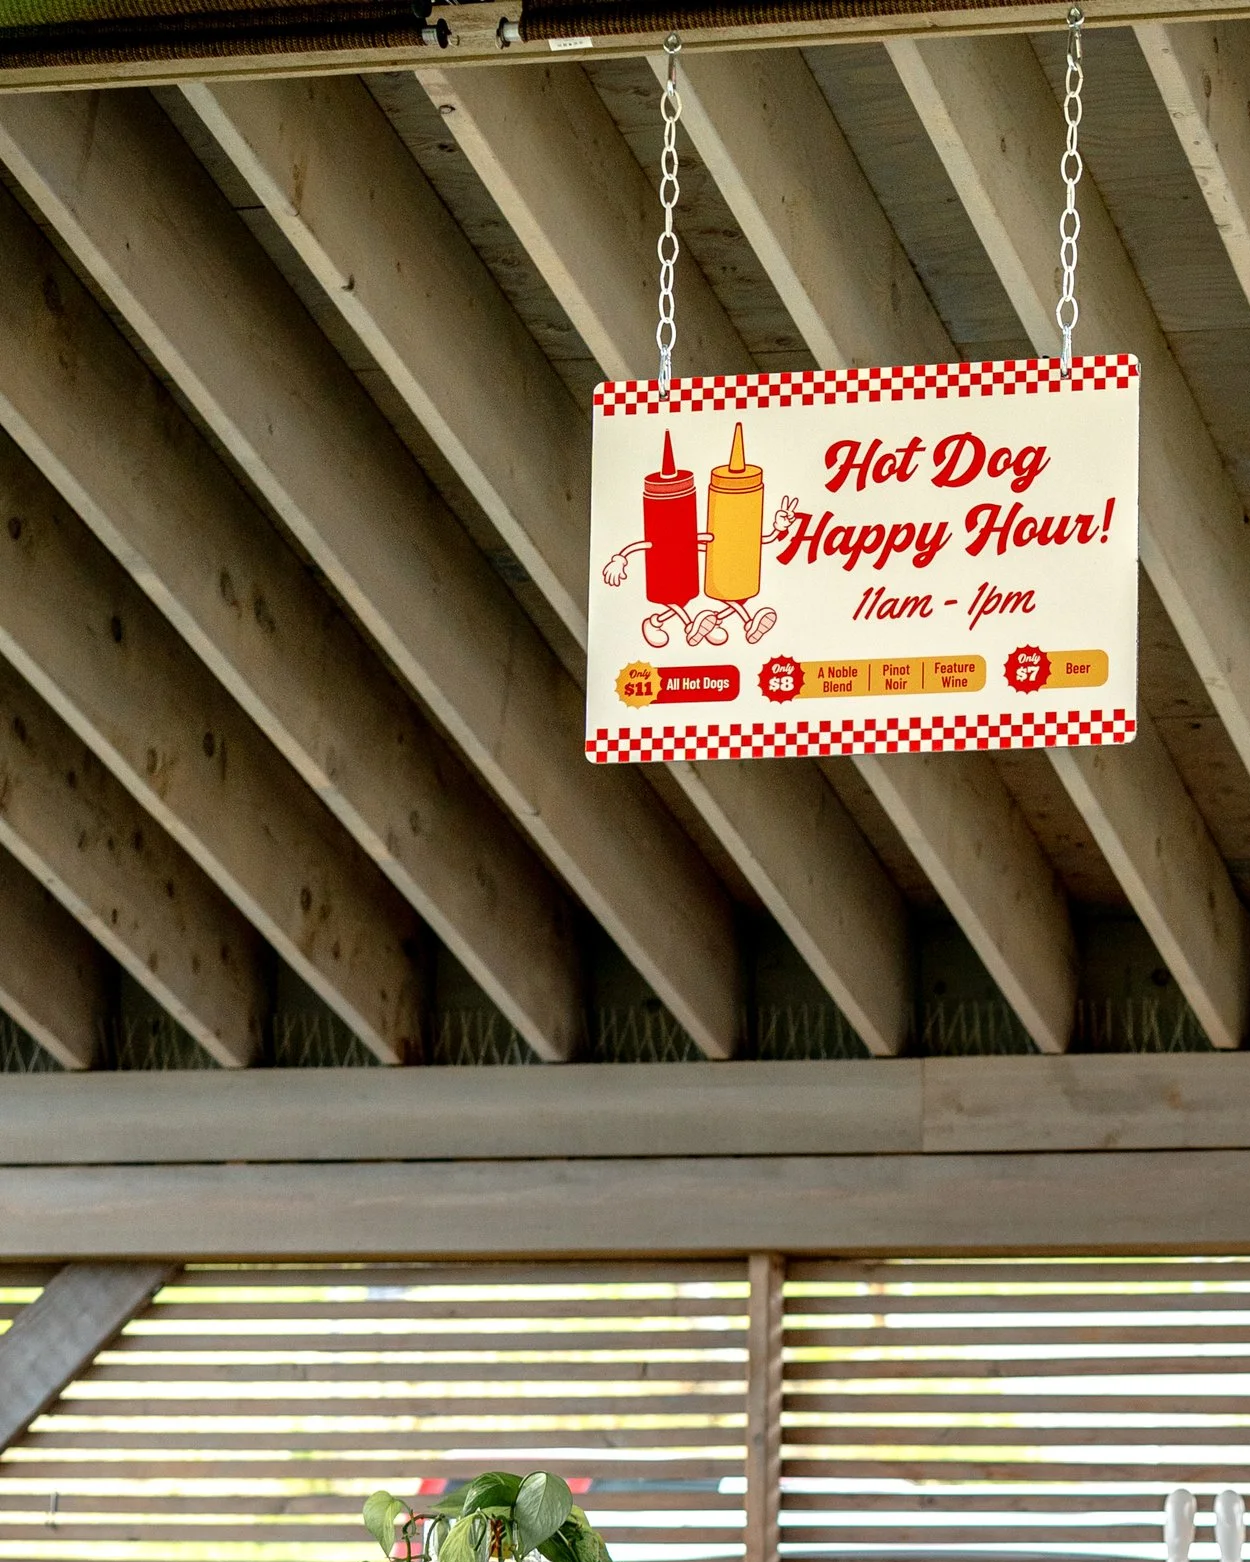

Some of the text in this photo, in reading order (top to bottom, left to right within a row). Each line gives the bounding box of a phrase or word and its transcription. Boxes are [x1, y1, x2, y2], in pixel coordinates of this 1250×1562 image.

[824, 432, 1051, 493] Hot Dog
[776, 497, 1116, 572] Happy Hour!
[852, 586, 934, 621] 11am
[967, 581, 1036, 631] 1pm
[1017, 653, 1041, 665] Only
[629, 669, 651, 680] Only
[771, 662, 795, 674] Only
[818, 666, 858, 679] A Noble
[882, 664, 910, 677] Pinot
[934, 661, 976, 675] Feature
[1016, 665, 1040, 682] $7
[1065, 662, 1091, 675] Beer
[666, 677, 730, 691] All Hot Dogs
[769, 676, 795, 692] $8
[823, 680, 853, 693] Blend
[885, 678, 908, 691] Noir
[941, 675, 968, 688] Wine
[624, 681, 653, 697] $11
